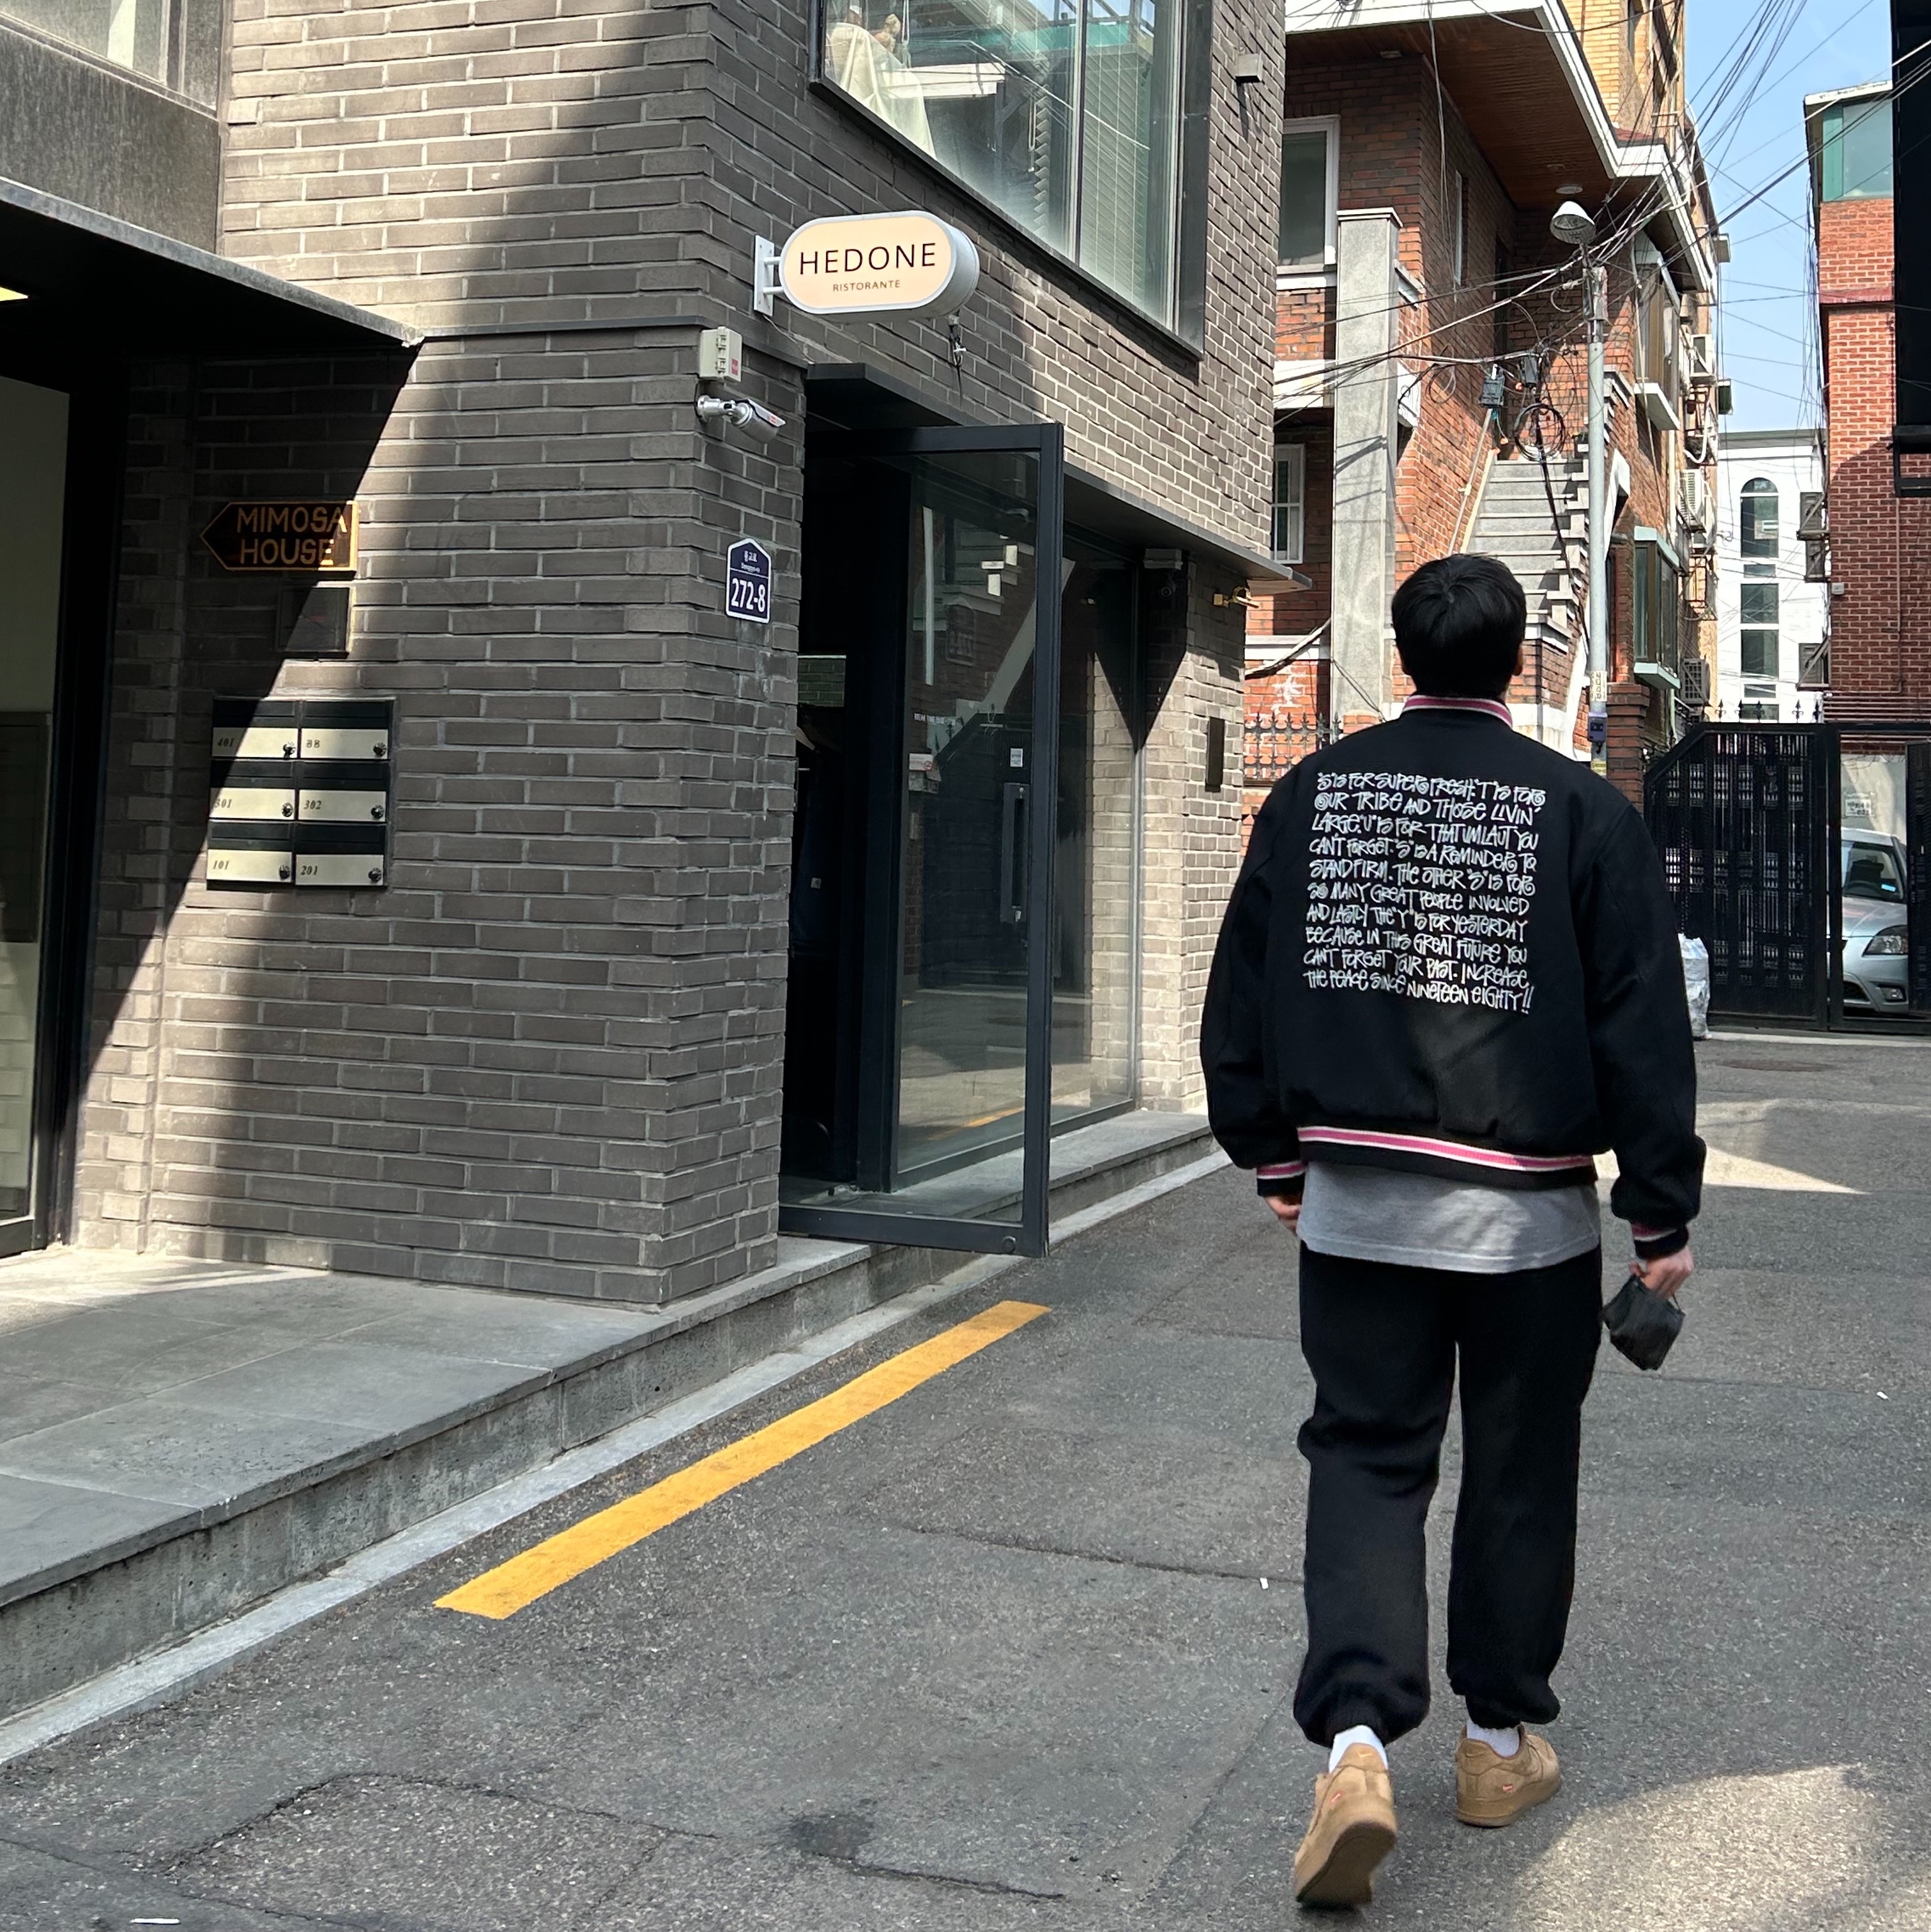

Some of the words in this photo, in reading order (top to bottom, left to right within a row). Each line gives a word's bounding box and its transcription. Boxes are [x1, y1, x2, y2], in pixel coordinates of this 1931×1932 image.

[800, 243, 936, 275] HEDONE
[832, 280, 901, 292] RISTORANTE
[236, 507, 347, 533] MIMOSA
[240, 538, 334, 565] HOUSE
[731, 578, 766, 613] 272-8
[217, 737, 234, 747] 401
[1348, 772, 1375, 790] FOR
[215, 799, 232, 808] 301
[303, 800, 322, 809] 302
[1315, 792, 1349, 811] OUR
[1352, 792, 1403, 811] TRIBE
[1403, 798, 1431, 815] AND
[1433, 797, 1486, 822] THOSE
[1395, 817, 1427, 837] FOR
[1424, 824, 1466, 843] THAT
[1463, 824, 1518, 850] UMLAUT
[1513, 830, 1539, 851] YOU
[212, 860, 229, 870] 101
[300, 865, 318, 875] 201
[1439, 845, 1518, 873] REMINDER
[1309, 859, 1353, 879] STAND
[1392, 862, 1419, 886] THE
[1422, 867, 1467, 889] OTHER
[1330, 882, 1371, 903] MANY
[1370, 884, 1419, 912] GREAT
[1419, 890, 1463, 910] PEOPLE
[1469, 894, 1530, 916] INVOLVED
[1306, 903, 1330, 923] AND
[1329, 903, 1368, 926] LASTLY
[1370, 907, 1395, 925] THE
[1428, 913, 1452, 931] FOR
[1451, 914, 1528, 942] YESTERDAY
[1306, 925, 1364, 947] BECAUSE
[1366, 928, 1380, 945] IN
[1382, 931, 1412, 950] THIS
[1414, 933, 1456, 956] GREAT
[1456, 938, 1501, 963] FUTURE
[1504, 944, 1527, 965] YOU
[1341, 949, 1393, 969] FORGET
[1394, 953, 1423, 976] YOUR
[1461, 963, 1530, 988] INCREASE
[1302, 970, 1328, 988] THE
[1329, 969, 1369, 990] PEACE
[1370, 972, 1406, 994] SINCE
[1407, 980, 1469, 1005] NINETEEN
